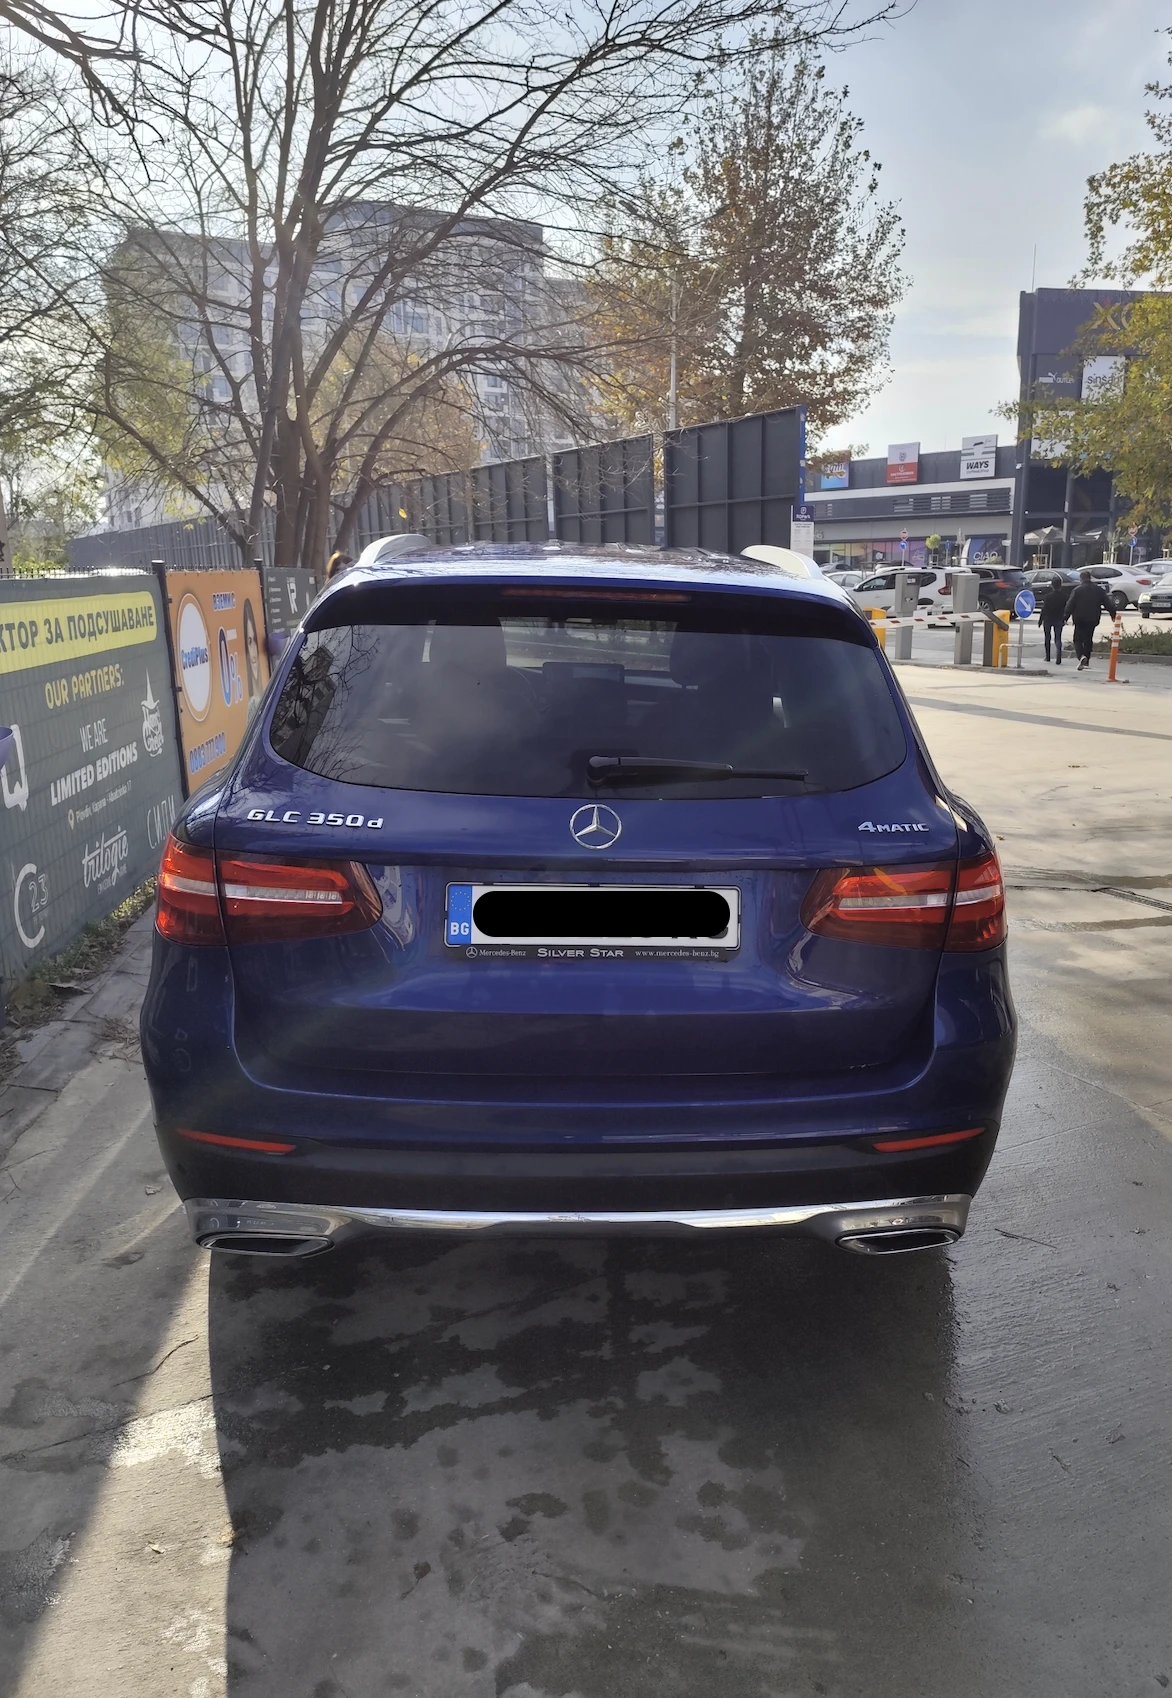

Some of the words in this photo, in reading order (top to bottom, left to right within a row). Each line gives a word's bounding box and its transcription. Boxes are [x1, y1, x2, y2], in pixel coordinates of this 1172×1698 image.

[966, 460, 989, 470] WAYS
[44, 617, 64, 645] ЗА
[67, 606, 154, 642] ПОДСУШАВАНЕ
[45, 678, 69, 709] OUR
[71, 663, 124, 701] PARTNERS:
[80, 724, 94, 753] WE
[94, 718, 108, 747] ARE
[50, 764, 94, 807] LIMITED
[96, 741, 138, 782] EDITIONS
[247, 809, 301, 822] GLC
[858, 821, 929, 833] 4MATIC
[450, 922, 470, 936] BG
[479, 949, 527, 957] Mercedes-Benz
[537, 948, 585, 958] SILVER
[589, 948, 624, 958] STAR
[634, 949, 720, 958] www.mercedes-benz.bg
